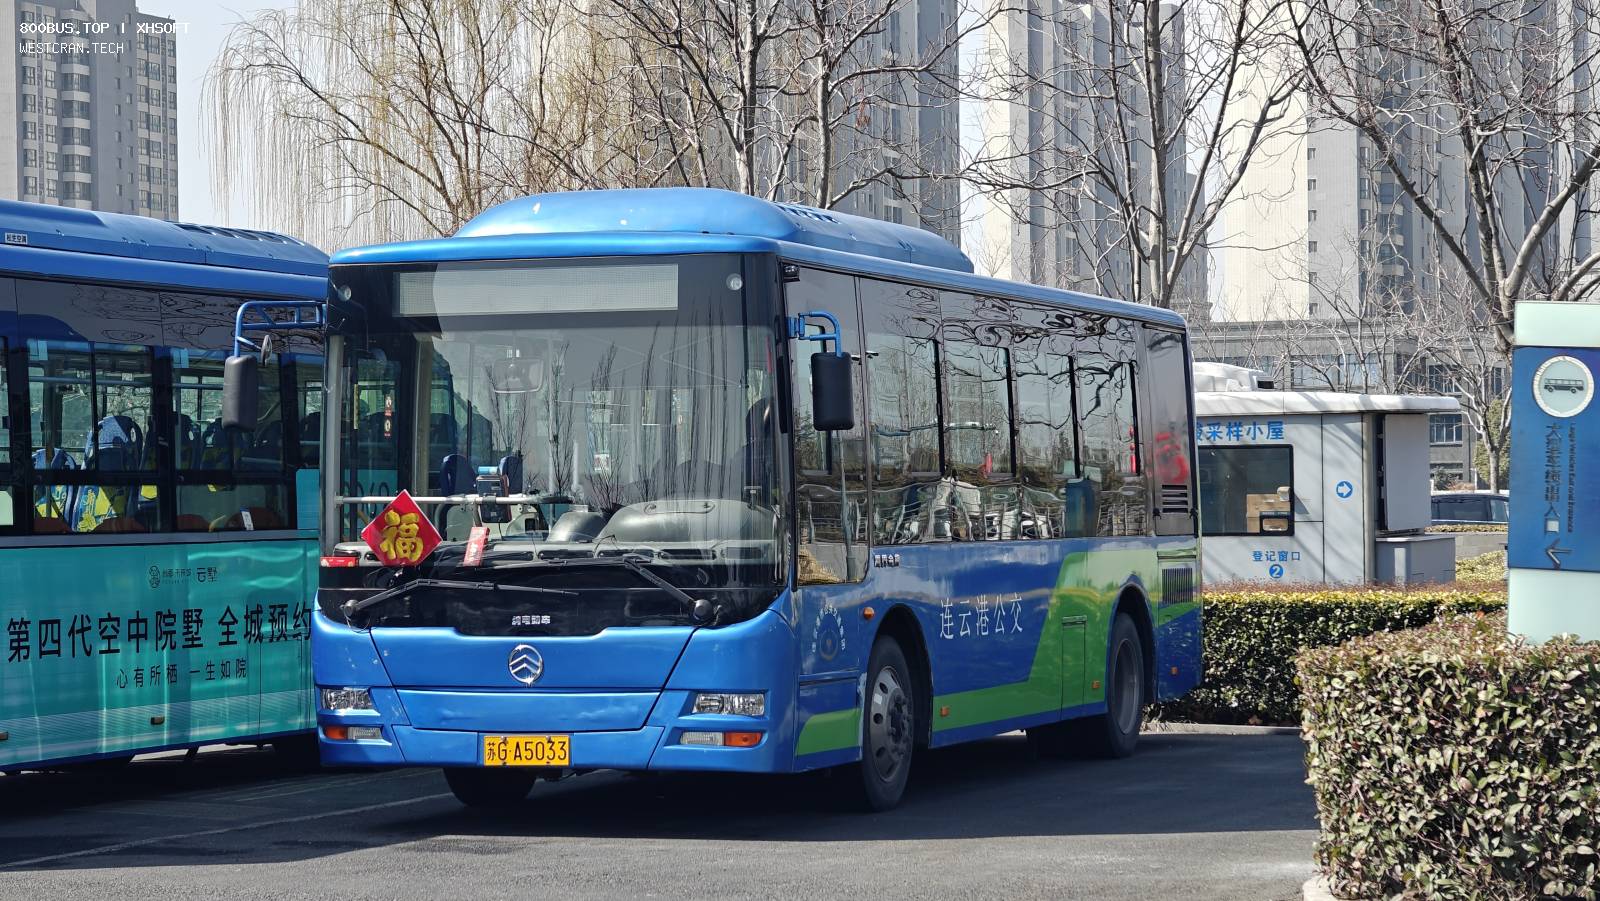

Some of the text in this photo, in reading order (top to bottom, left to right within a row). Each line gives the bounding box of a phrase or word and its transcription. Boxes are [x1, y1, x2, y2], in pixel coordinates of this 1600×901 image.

[380, 508, 424, 561] 福
[1252, 550, 1301, 562] 登记窗口
[1270, 564, 1282, 578] 2
[7, 602, 312, 663] 第四代空中院墅 全城预约
[939, 592, 1023, 640] 连云港公交
[116, 657, 248, 689] 心有所栖 一生如院
